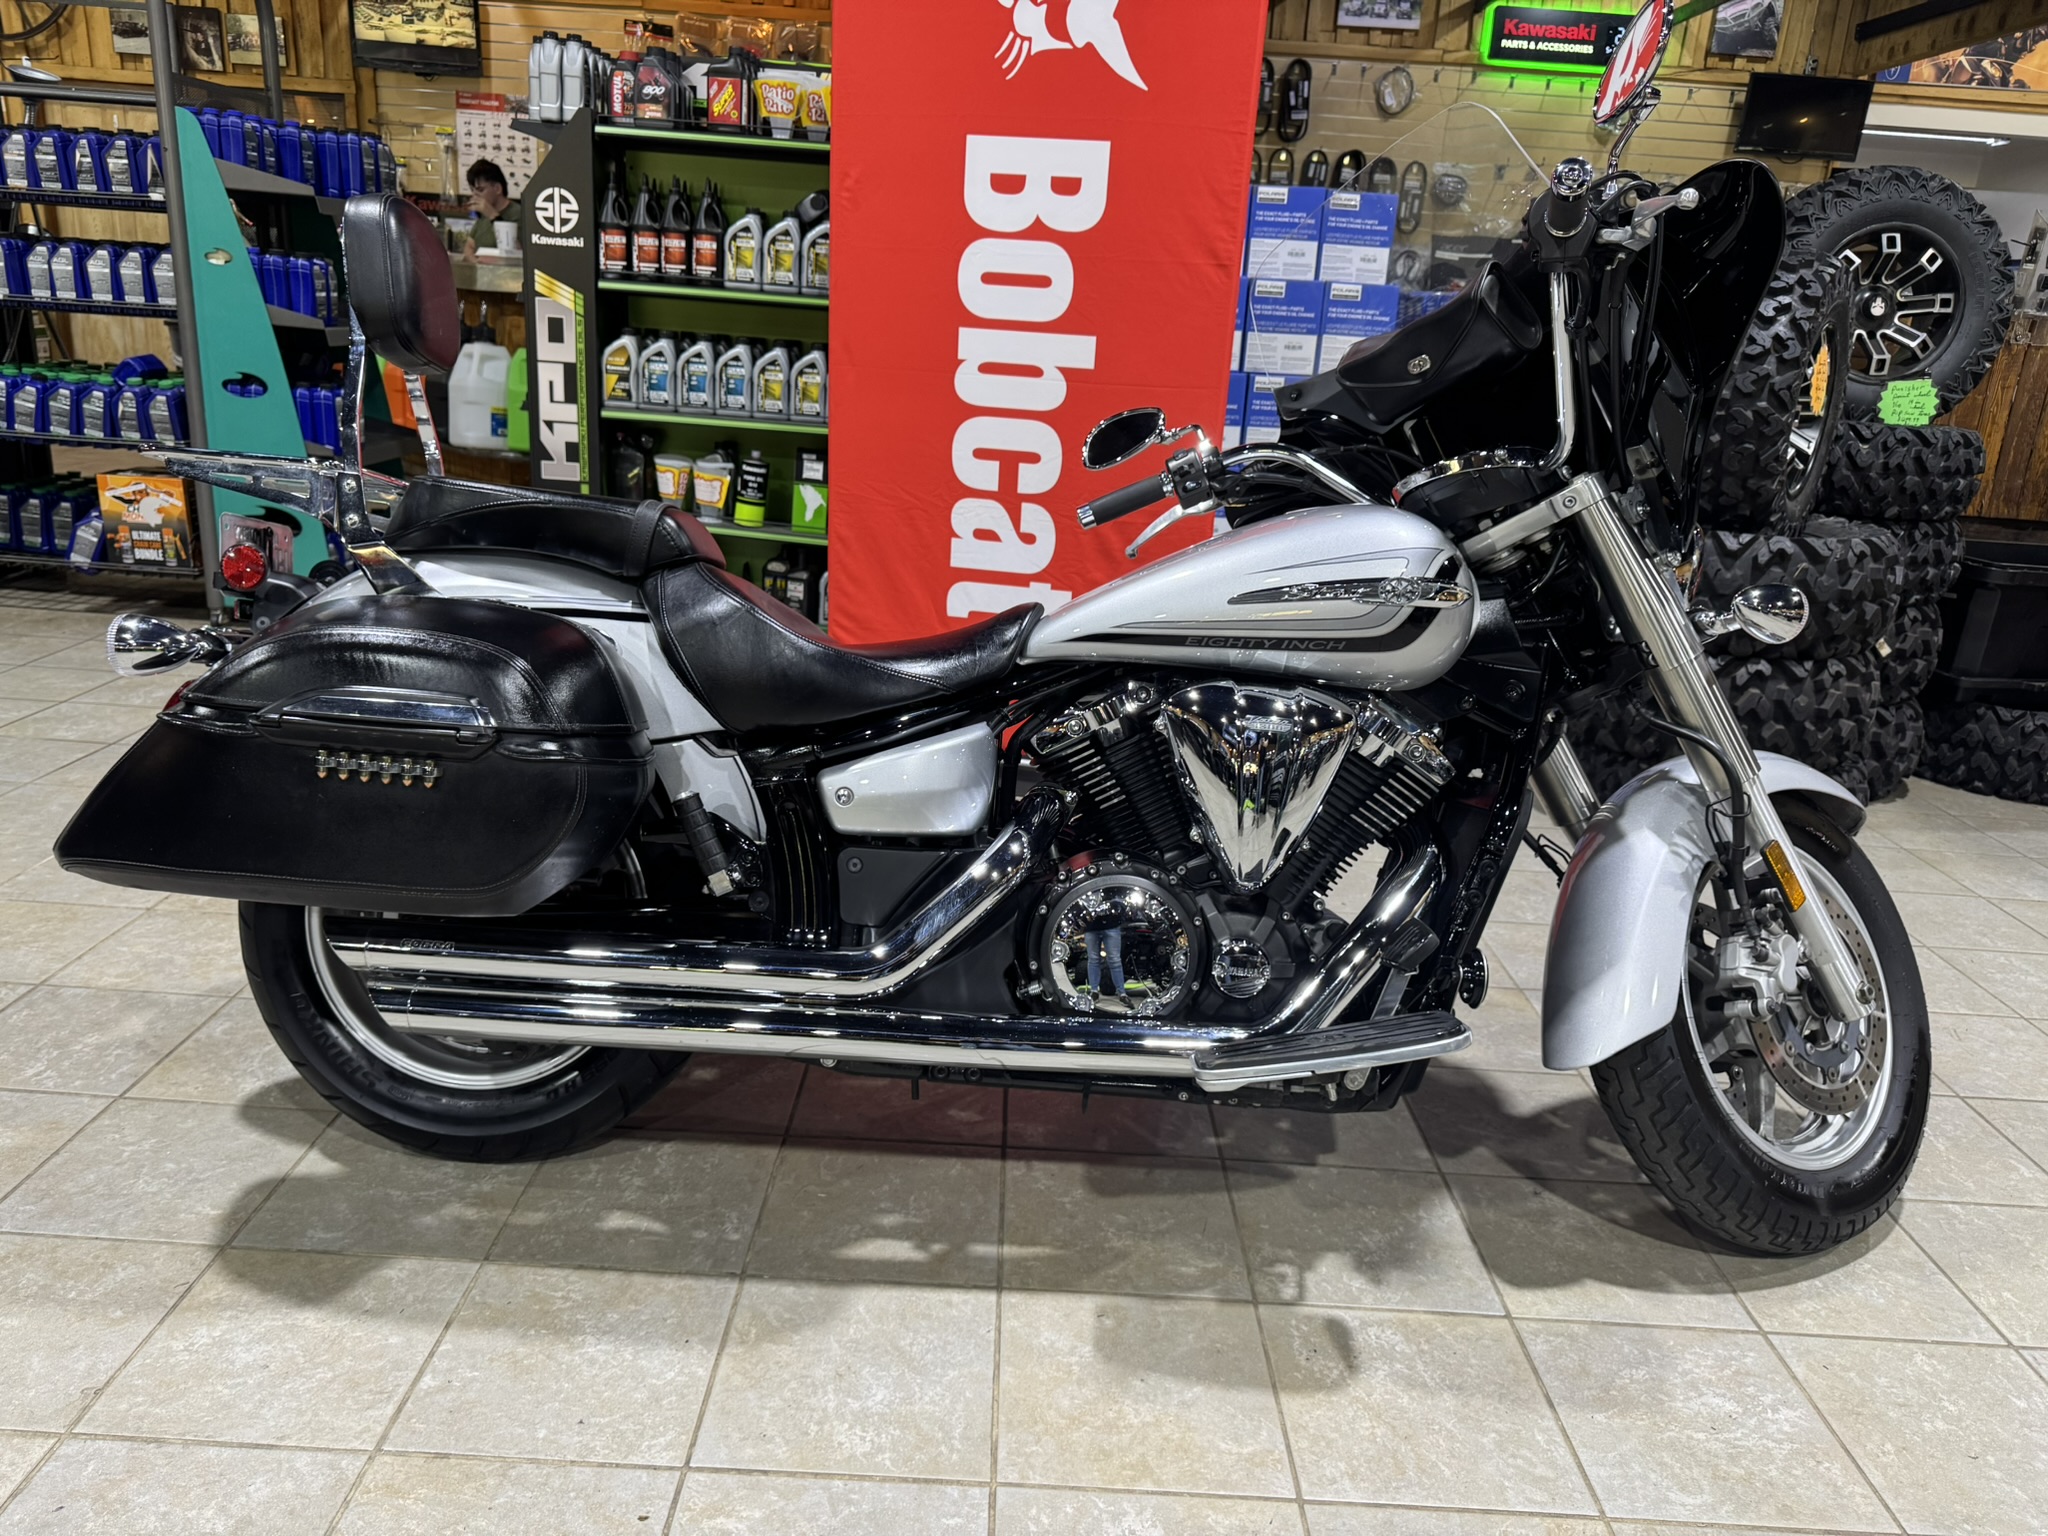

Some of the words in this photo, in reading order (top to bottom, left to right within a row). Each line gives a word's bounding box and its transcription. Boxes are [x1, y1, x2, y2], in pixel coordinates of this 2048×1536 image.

[1503, 18, 1598, 41] Kawasaki
[1501, 39, 1528, 49] PARTS
[1529, 41, 1535, 50] &
[1537, 41, 1594, 54] ACCESSORIES
[613, 76, 623, 114] MOTUL
[642, 84, 666, 95] 800
[531, 233, 584, 248] Kawasaki
[946, 134, 1111, 618] Bobcat
[535, 296, 581, 481] KPO
[578, 348, 587, 427] PERFORMANCE
[581, 428, 589, 481] KAWASAKI
[132, 530, 161, 541] ULTIMATE
[134, 548, 164, 561] BUNDLE
[1185, 636, 1278, 649] EIGHTY
[1280, 639, 1346, 650] INCH
